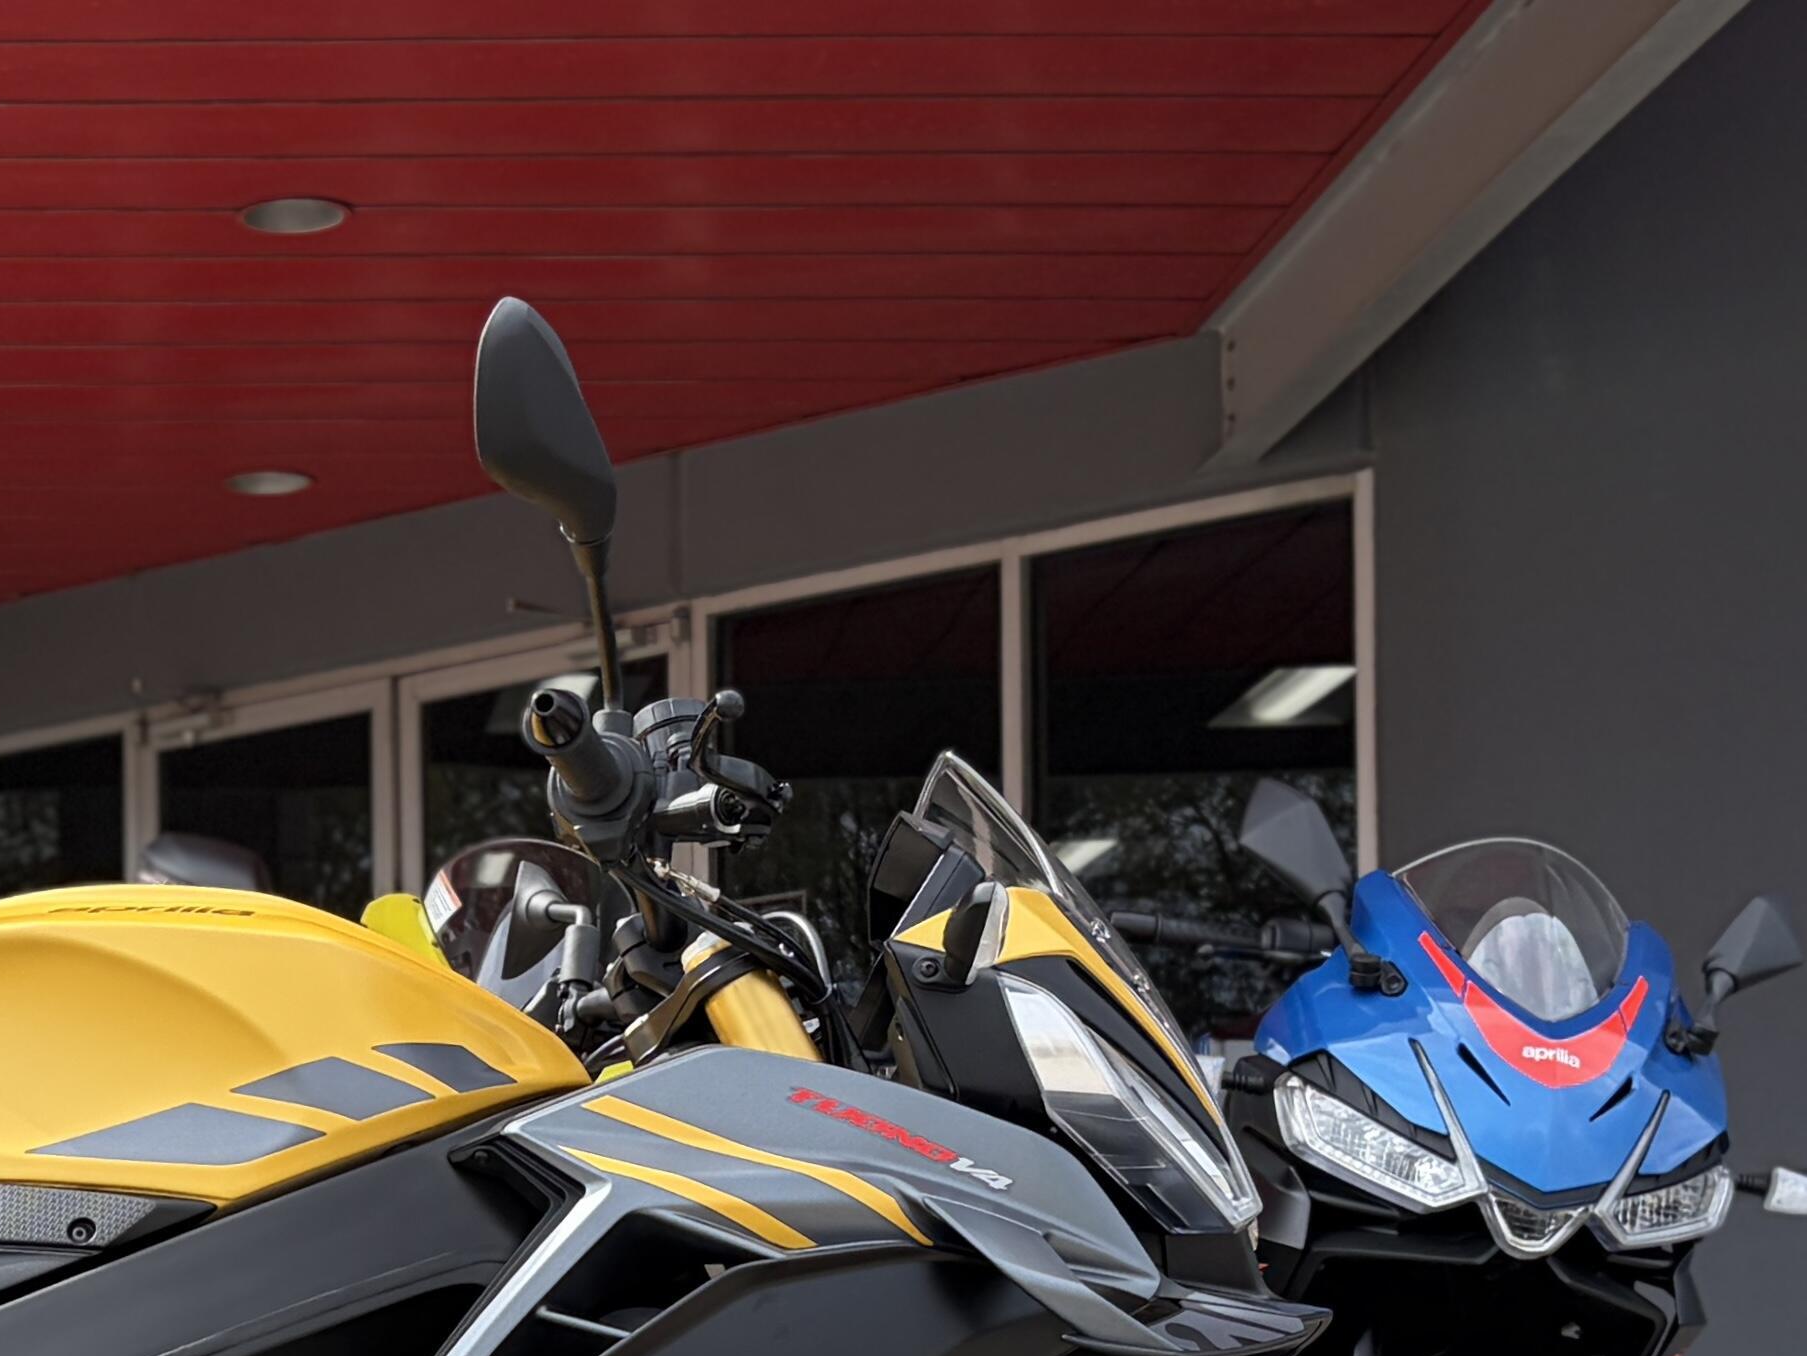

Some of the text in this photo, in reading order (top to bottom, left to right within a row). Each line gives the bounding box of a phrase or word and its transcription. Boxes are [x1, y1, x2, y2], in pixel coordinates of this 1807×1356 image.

[48, 905, 257, 917] aprilia
[1522, 1045, 1581, 1070] aprilia
[949, 1157, 1013, 1191] V4
